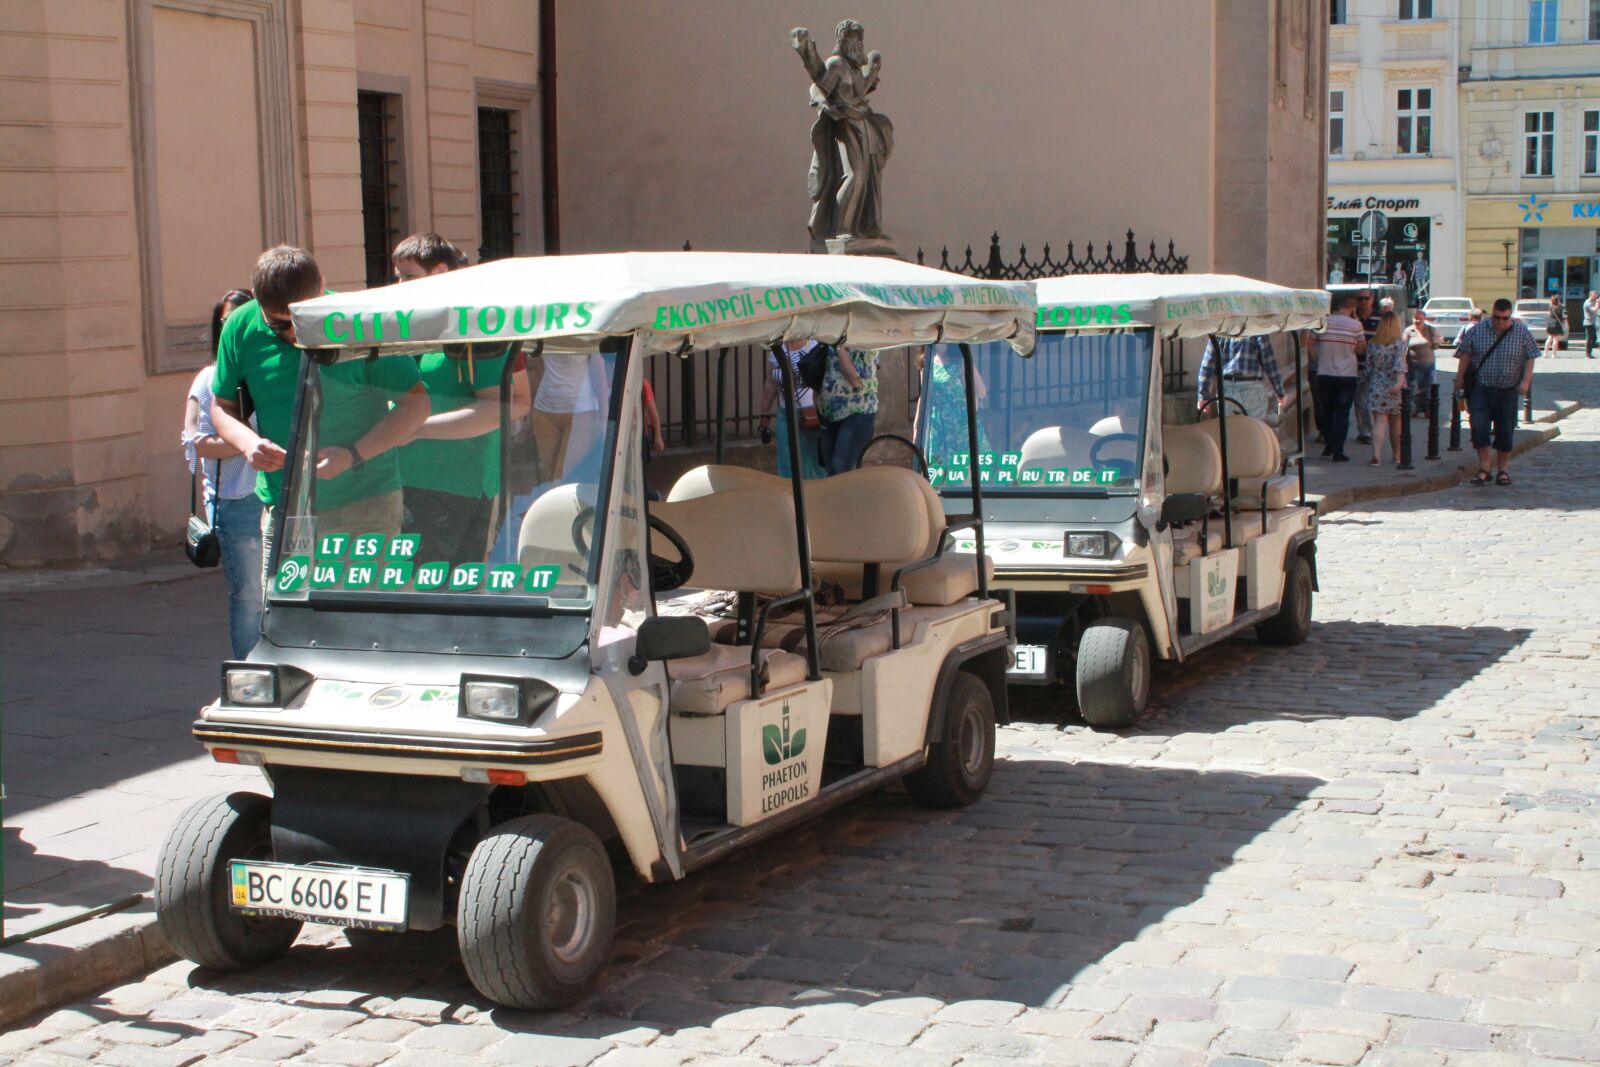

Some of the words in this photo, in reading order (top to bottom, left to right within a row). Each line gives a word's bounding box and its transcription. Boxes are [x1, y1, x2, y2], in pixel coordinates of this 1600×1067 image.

[1365, 196, 1419, 211] Спорт
[324, 309, 415, 342] CITY
[453, 300, 594, 336] TOURS
[1036, 304, 1133, 327] TOURS
[952, 454, 968, 465] LT
[978, 454, 993, 465] ES
[1001, 454, 1018, 465] FR
[949, 470, 964, 481] UA
[998, 471, 1013, 482] PL
[1022, 470, 1040, 482] RU
[1048, 471, 1065, 482] TR
[1072, 471, 1091, 482] DE
[1101, 471, 1115, 482] IT
[321, 537, 344, 555] LT
[355, 538, 378, 556] ES
[390, 538, 414, 556] FR
[313, 566, 336, 583] UA
[348, 567, 371, 584] EN
[383, 567, 405, 585] PL
[418, 567, 444, 585] RU
[453, 568, 479, 585] DE
[490, 571, 516, 588] TR
[532, 570, 553, 588] IT
[762, 760, 807, 791] PHAETON
[762, 780, 809, 814] LEOPOLIS
[248, 872, 283, 904] BC
[291, 876, 349, 911] 6606
[357, 881, 387, 914] EI
